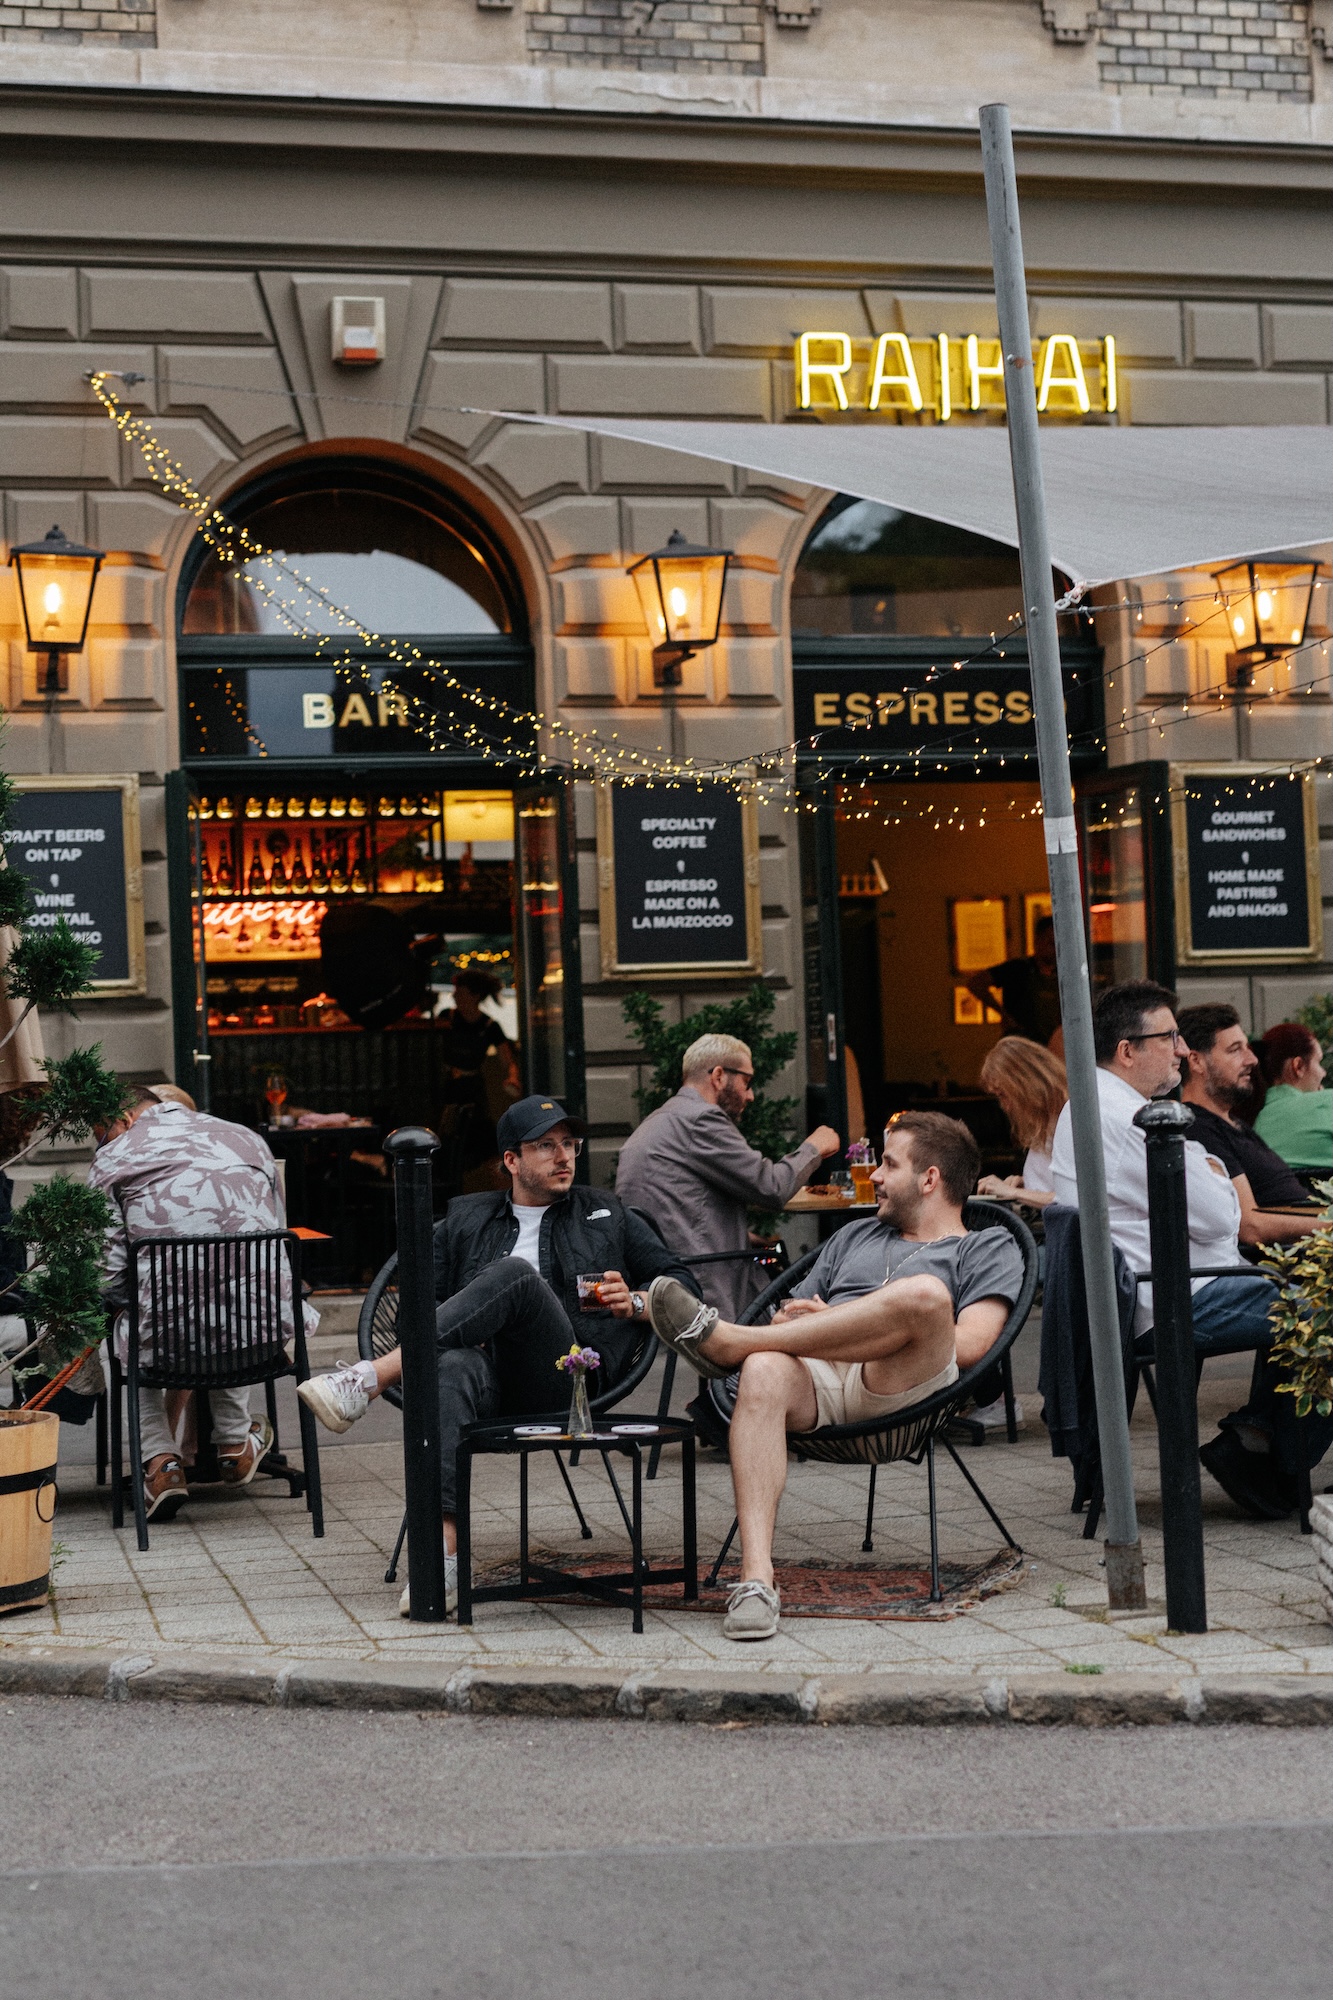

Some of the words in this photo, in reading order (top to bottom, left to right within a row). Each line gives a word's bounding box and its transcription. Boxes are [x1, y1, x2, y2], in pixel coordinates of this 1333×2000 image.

[302, 693, 409, 728] BAR
[814, 691, 1067, 726] ESPRESS
[641, 818, 717, 831] SPECIALTY
[1211, 810, 1275, 825] GOURMET
[55, 829, 105, 842] BEERS
[1202, 827, 1287, 842] SANDWICHES
[652, 836, 707, 849] COFFEE
[25, 849, 49, 862] ON
[50, 848, 82, 862] TAP
[1208, 870, 1246, 883] HOME
[1247, 868, 1284, 882] MADE
[645, 879, 718, 893] ESPRESSO
[1216, 886, 1278, 900] PASTRIES
[34, 893, 75, 907] WINE
[644, 897, 685, 911] MADE
[686, 897, 707, 910] ON
[708, 897, 720, 910] A
[1207, 904, 1236, 918] AND
[1236, 903, 1288, 917] SNACKS
[632, 916, 652, 929] LA
[653, 914, 734, 928] MARZOCCO
